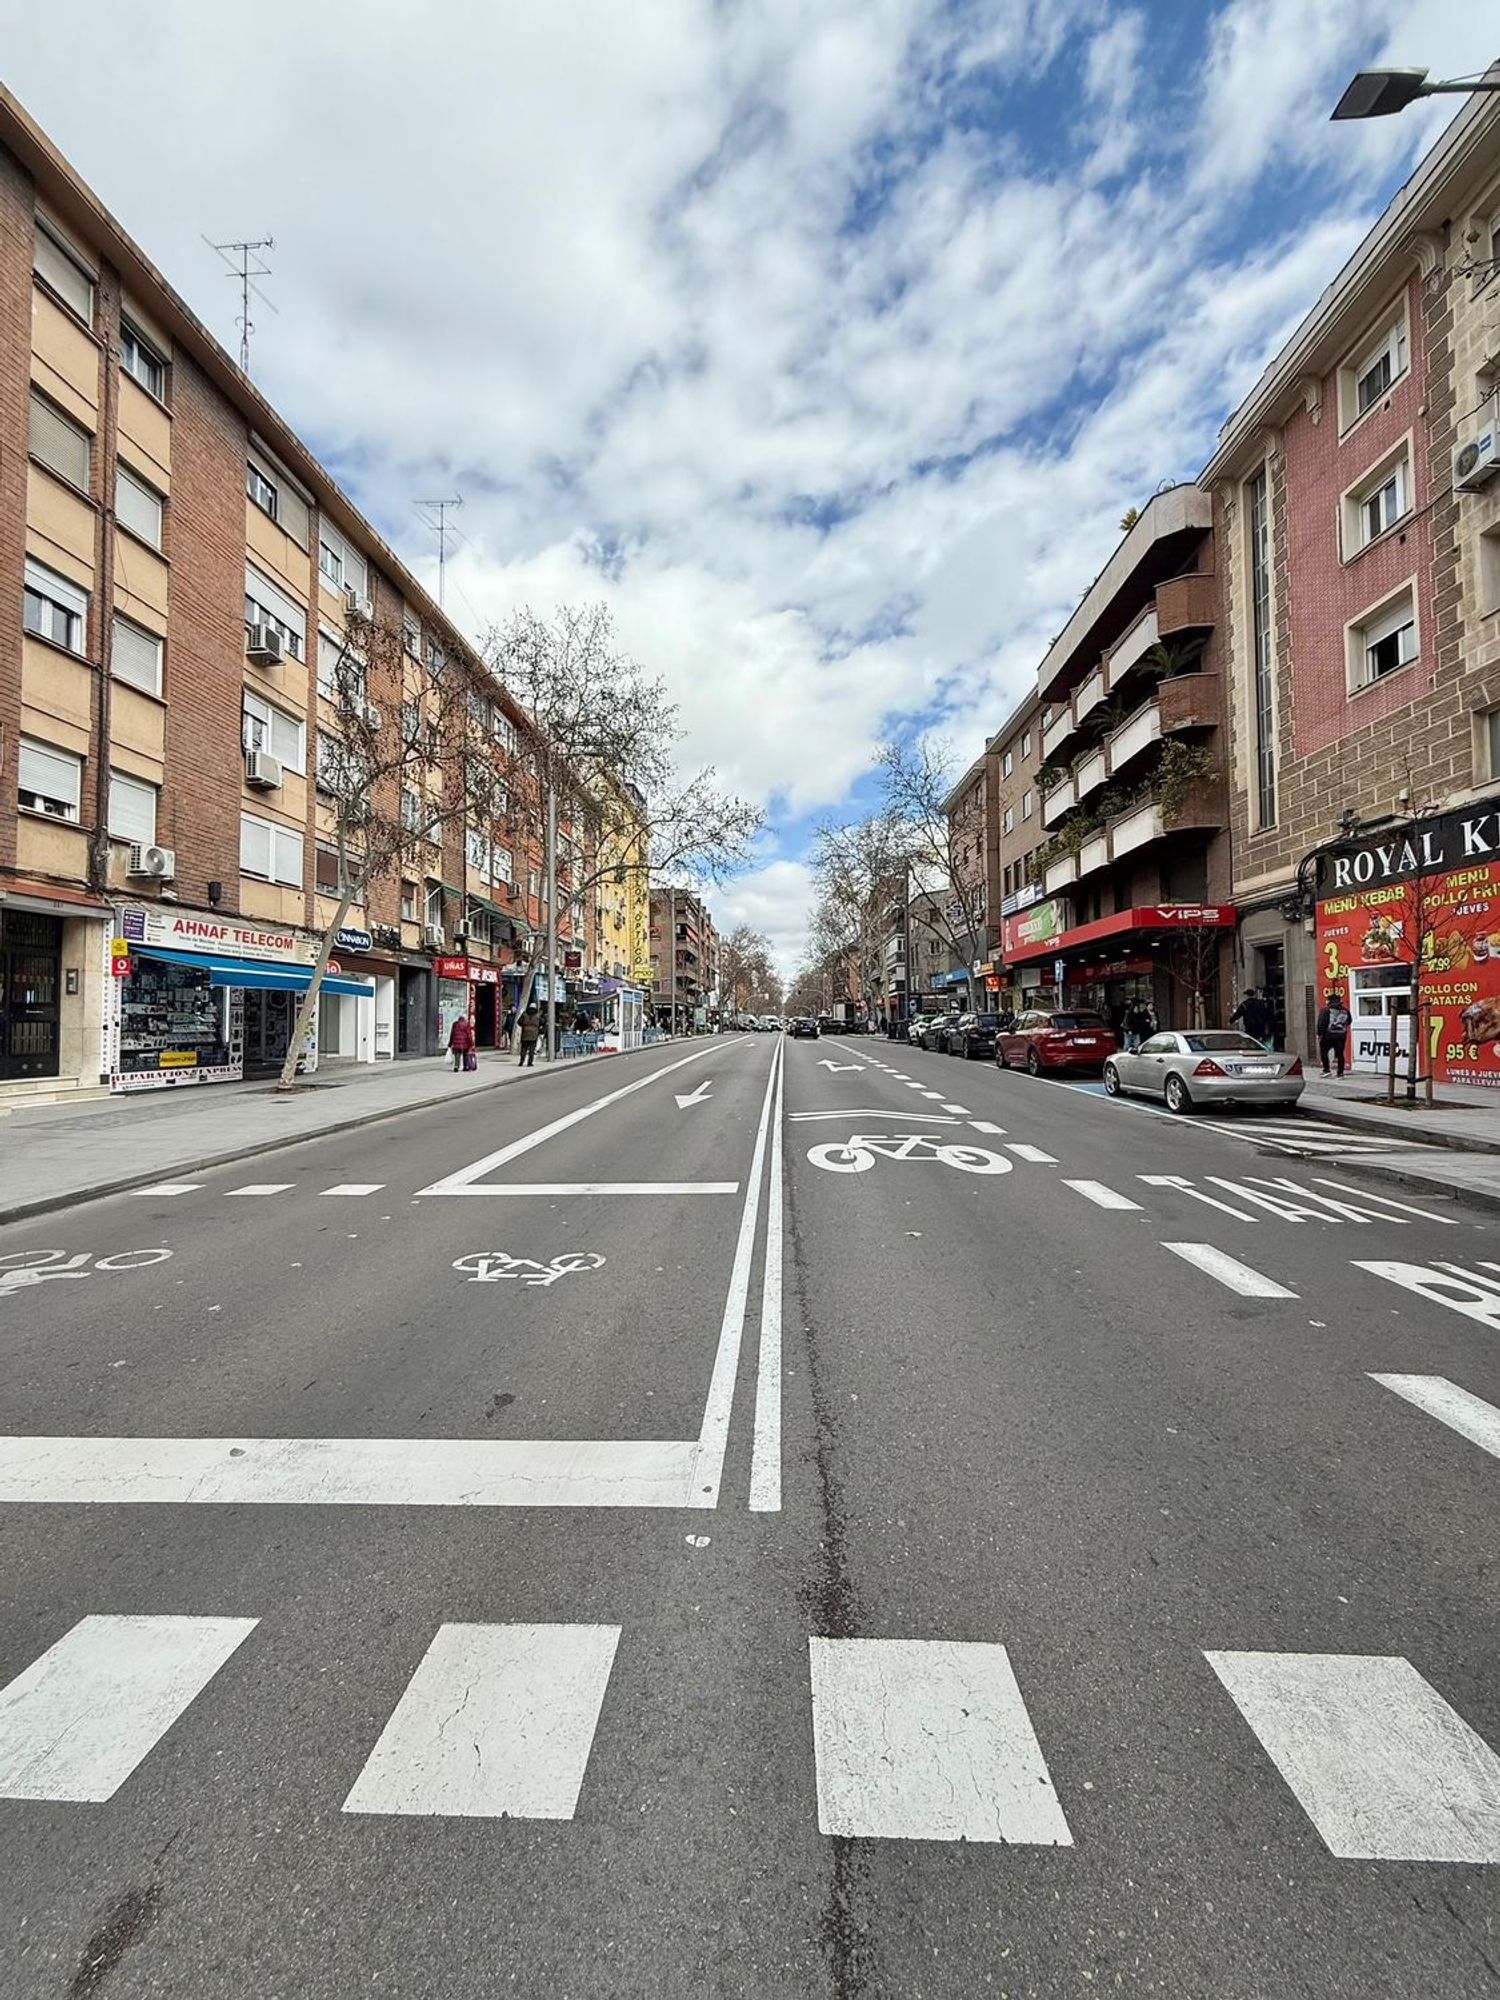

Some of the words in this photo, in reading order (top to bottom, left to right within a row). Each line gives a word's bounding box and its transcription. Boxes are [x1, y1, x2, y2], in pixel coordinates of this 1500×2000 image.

[1333, 832, 1444, 889] ROYAL
[1460, 814, 1500, 858] K
[1360, 886, 1405, 908] KEBAB
[1157, 909, 1220, 919] VIPS
[172, 919, 229, 940] AHNAF
[233, 929, 294, 950] TELECOM
[1453, 982, 1478, 992] CON
[1135, 1175, 1460, 1223] TAXI
